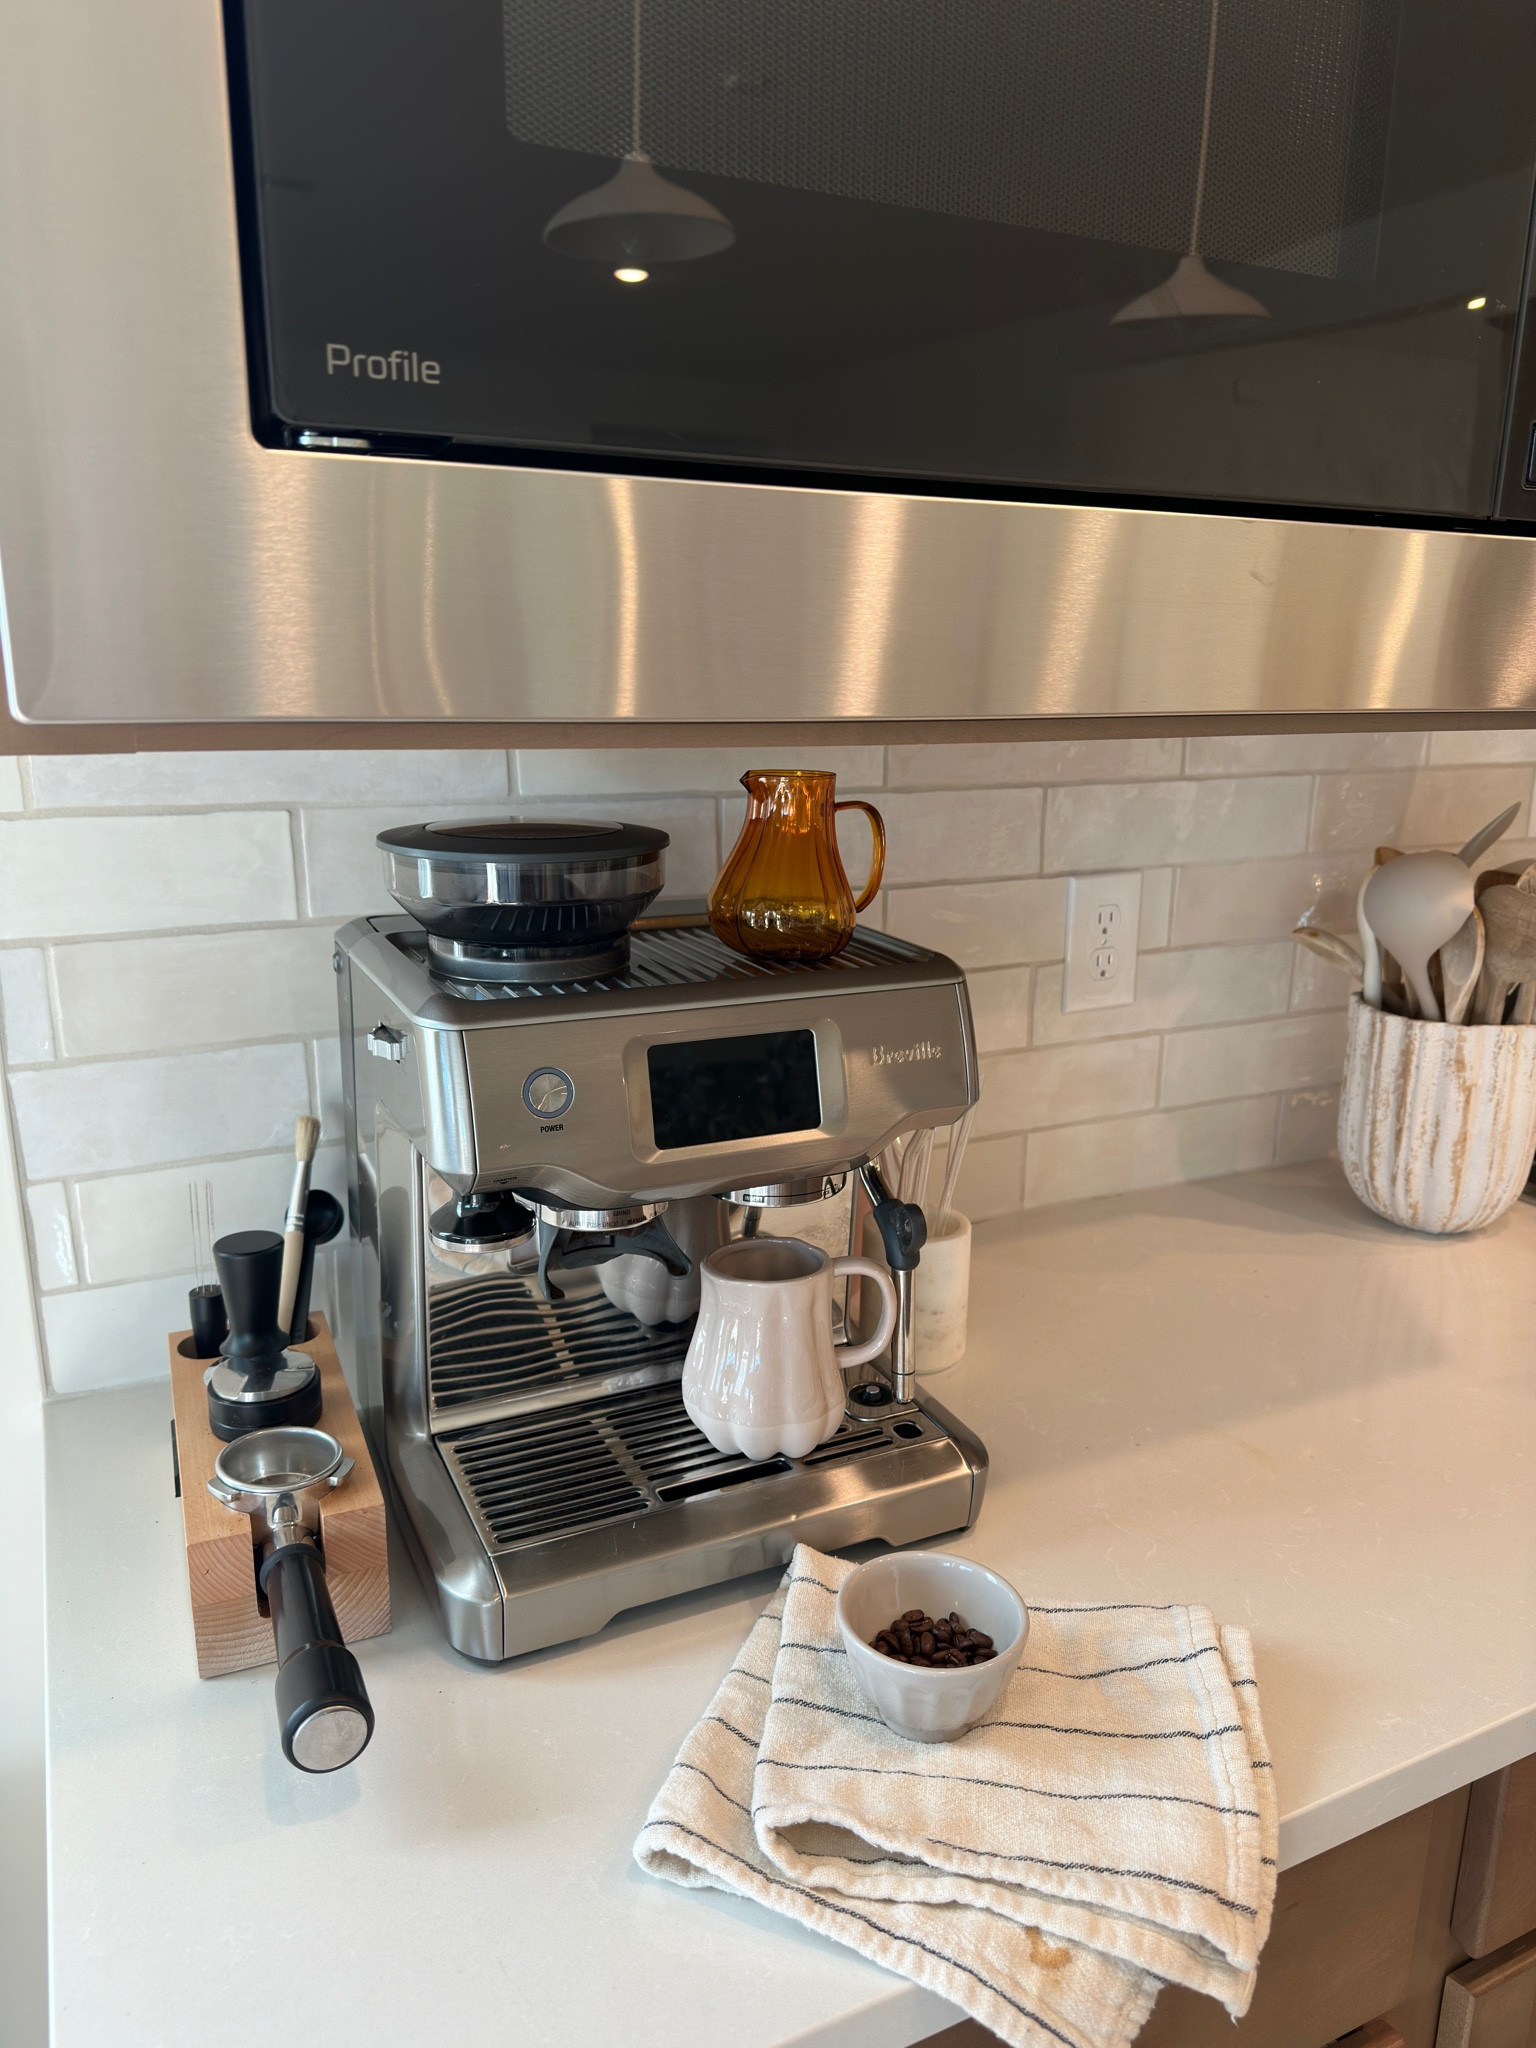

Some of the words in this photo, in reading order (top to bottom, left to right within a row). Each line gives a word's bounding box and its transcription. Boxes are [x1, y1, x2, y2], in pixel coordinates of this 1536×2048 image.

[326, 343, 441, 385] Profile
[872, 1041, 942, 1066] Breville
[540, 1124, 564, 1133] POWER
